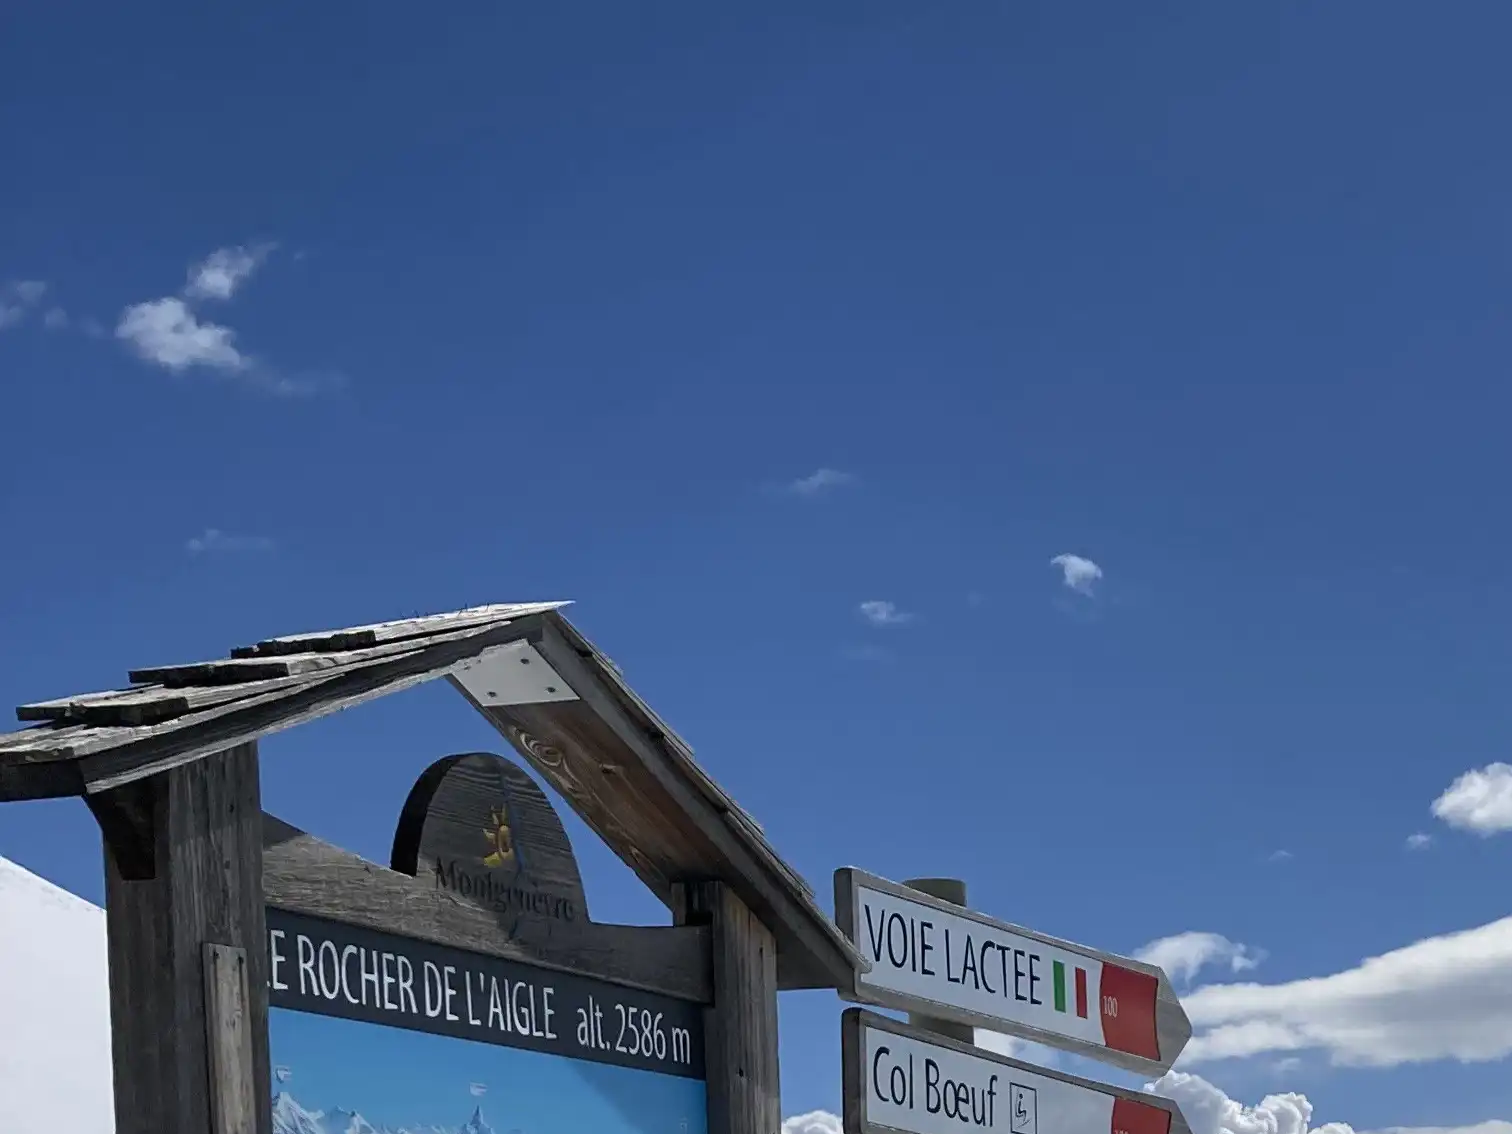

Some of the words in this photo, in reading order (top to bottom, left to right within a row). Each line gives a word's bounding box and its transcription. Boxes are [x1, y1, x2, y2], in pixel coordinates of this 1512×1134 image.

[266, 929, 289, 991] E
[297, 934, 418, 1014] ROCHER
[423, 960, 459, 1021] DE
[465, 970, 557, 1040] L'AIGLE
[576, 996, 611, 1051] alt.
[614, 1003, 667, 1060] 2586
[671, 1026, 691, 1065] m
[864, 904, 936, 976] VOIE
[944, 928, 1043, 1006] LACTEE
[1101, 994, 1118, 1019] 100
[872, 1046, 914, 1110] Col
[924, 1058, 998, 1128] Bœuf
